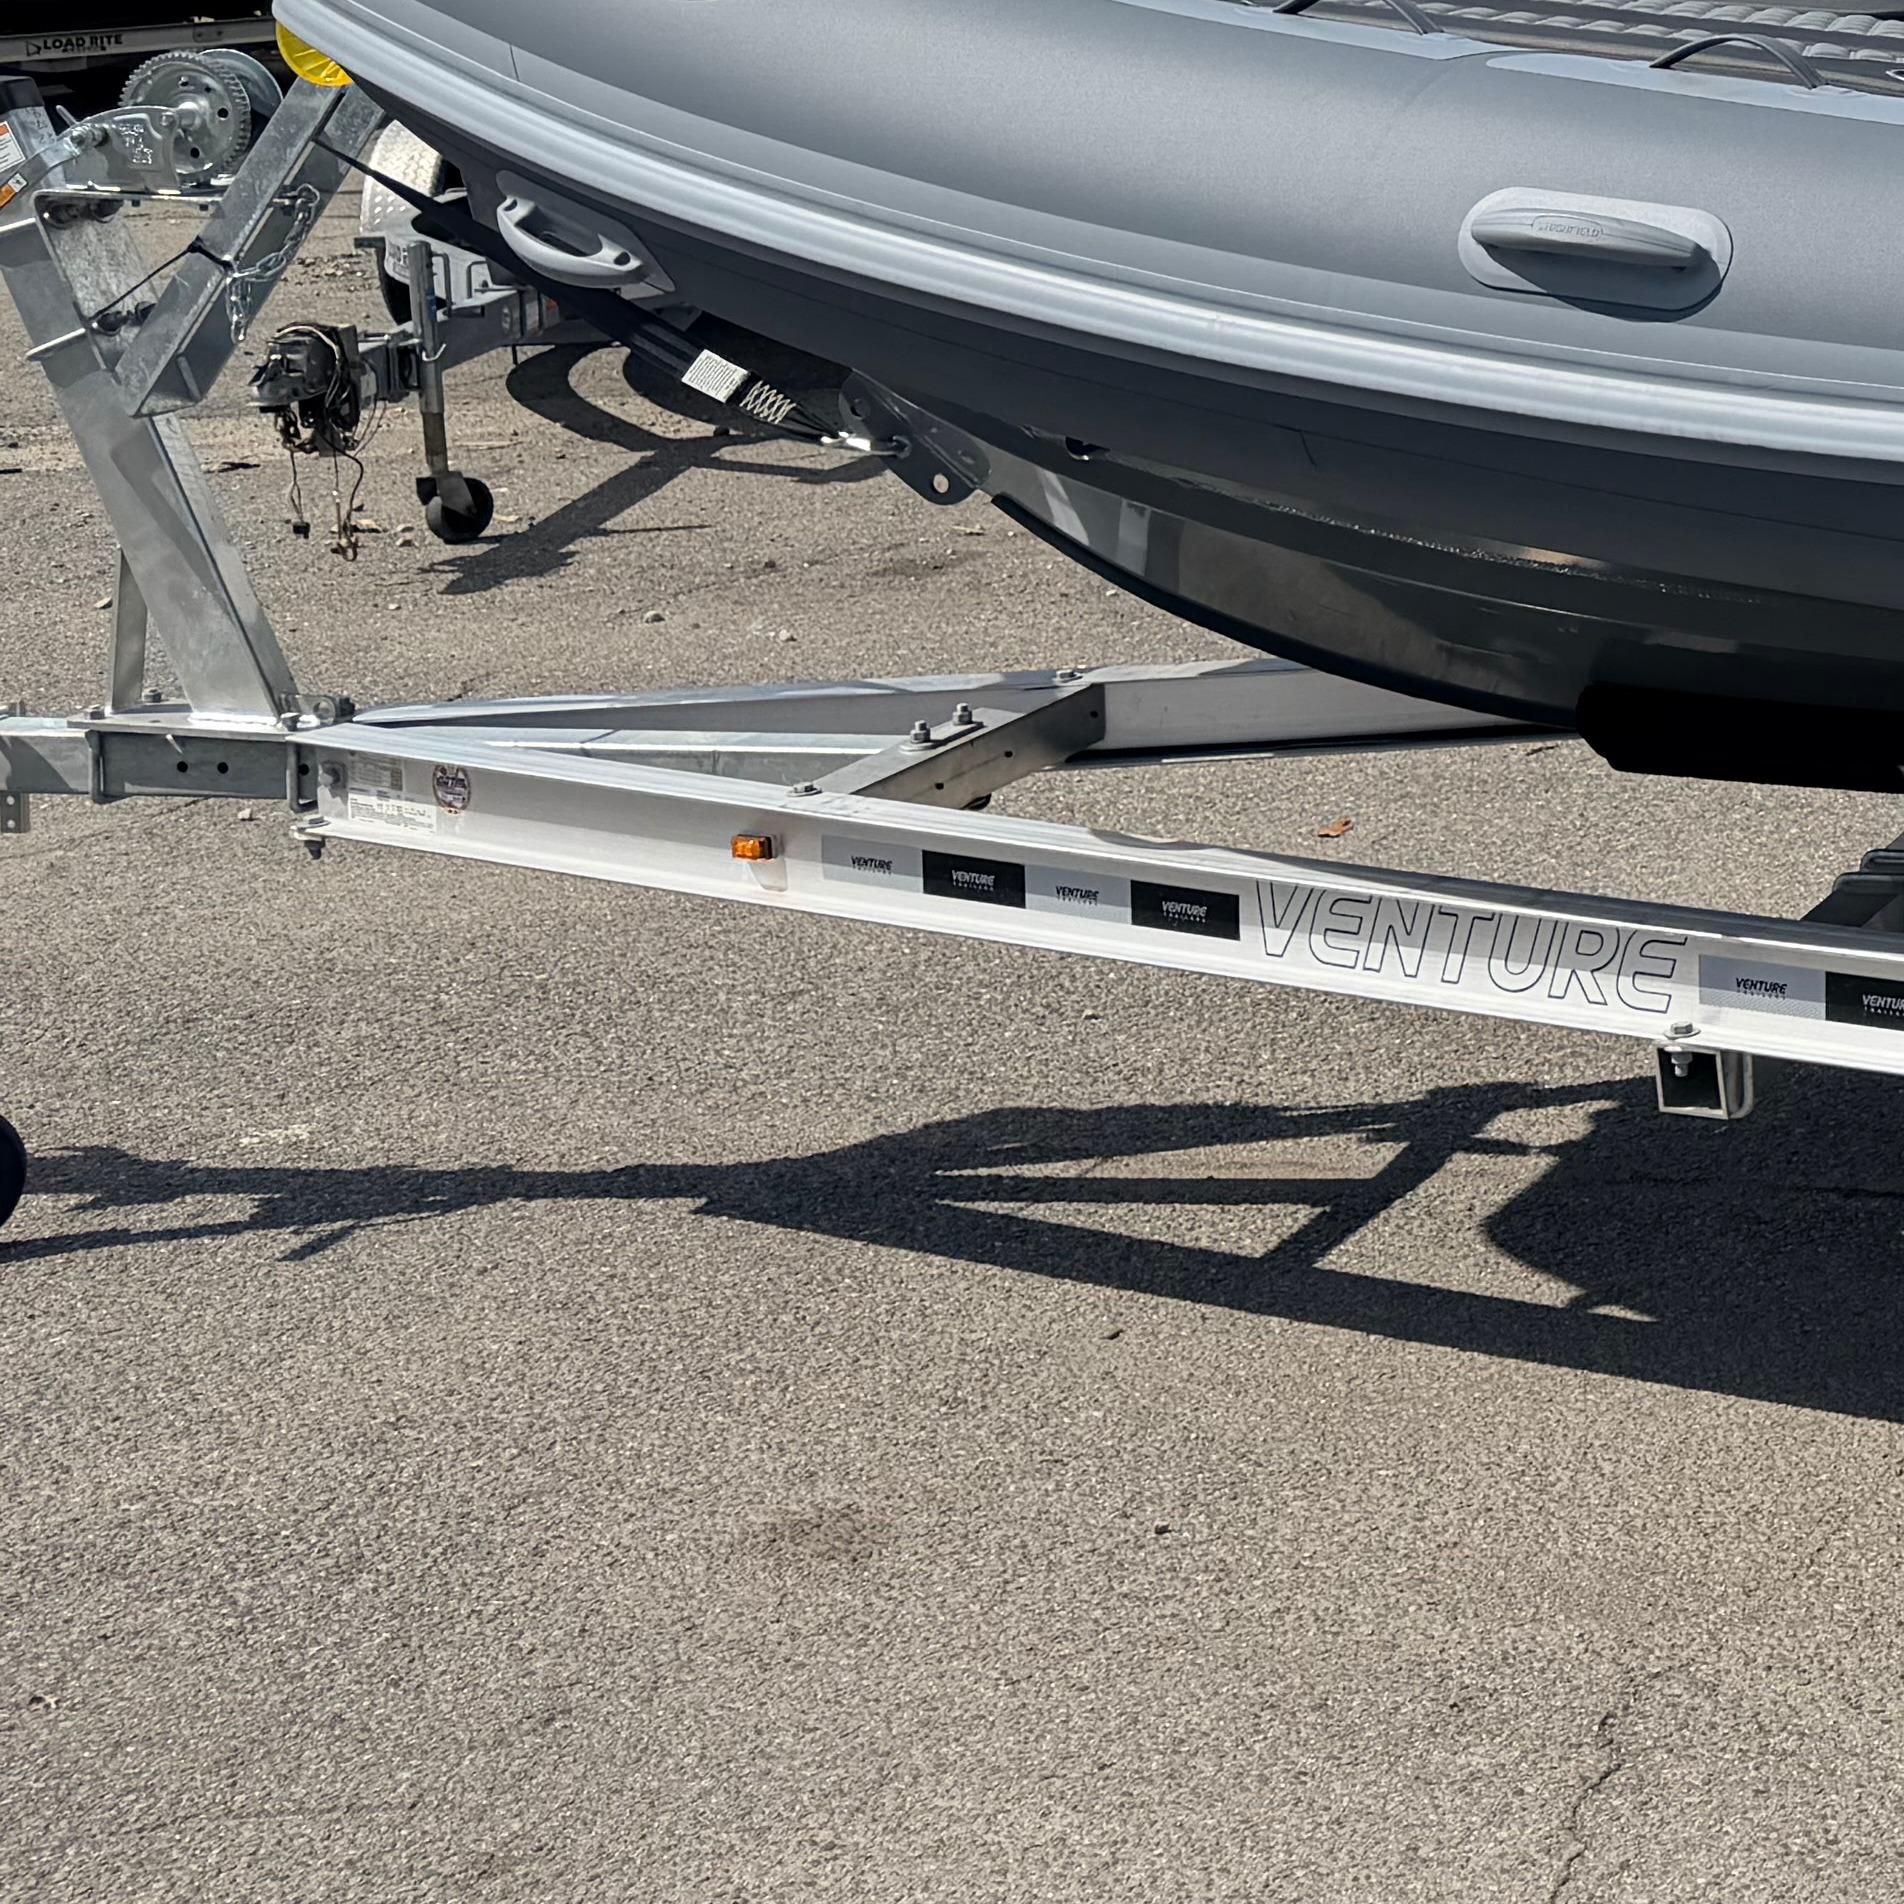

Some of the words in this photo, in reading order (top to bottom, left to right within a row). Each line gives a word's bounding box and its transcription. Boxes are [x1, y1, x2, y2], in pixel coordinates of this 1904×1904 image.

[43, 37, 86, 50] LOAD
[90, 34, 123, 46] RITE
[851, 855, 893, 870] VENTURE
[952, 869, 995, 886] VENTURE
[1055, 885, 1099, 902] VENTURE
[1162, 900, 1207, 917] VENTURE
[1256, 880, 1687, 1013] VENTURE
[1736, 977, 1787, 994] VENTURE
